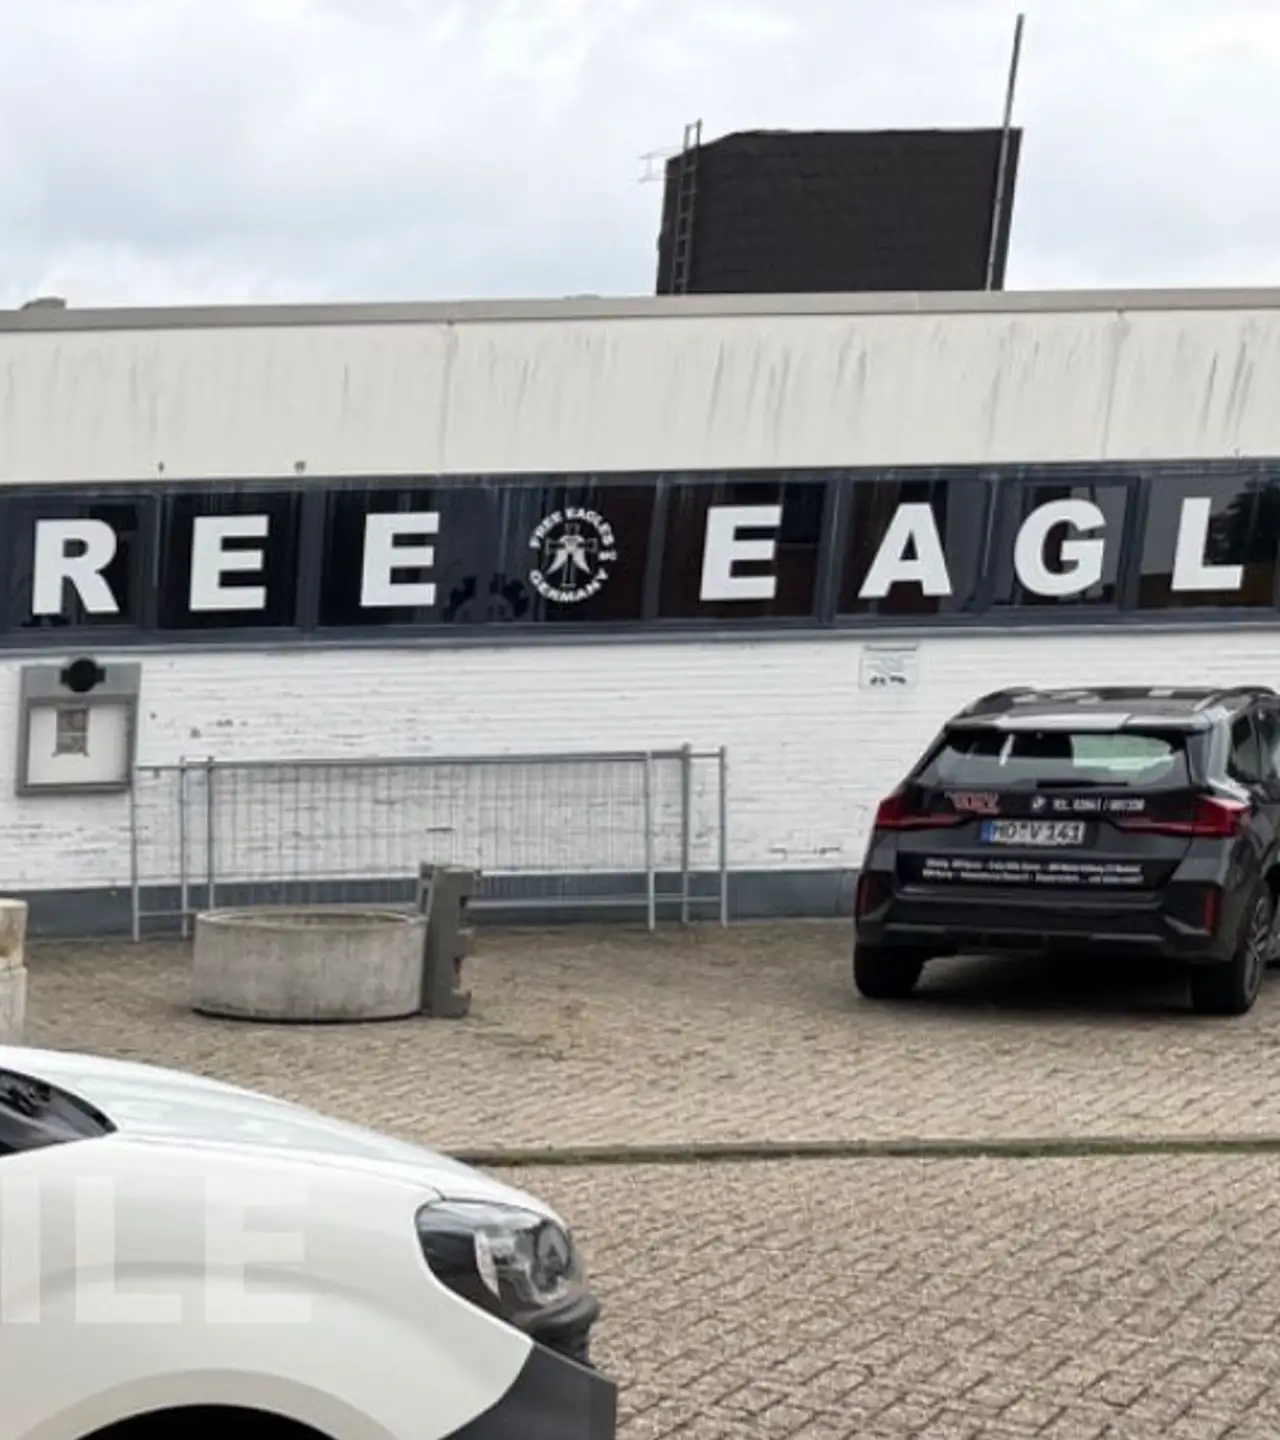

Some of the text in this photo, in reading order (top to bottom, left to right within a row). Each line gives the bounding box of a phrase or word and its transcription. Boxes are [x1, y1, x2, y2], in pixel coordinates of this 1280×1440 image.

[529, 510, 564, 549] FREE
[701, 498, 1243, 599] EAGL
[529, 568, 609, 603] GERMANY
